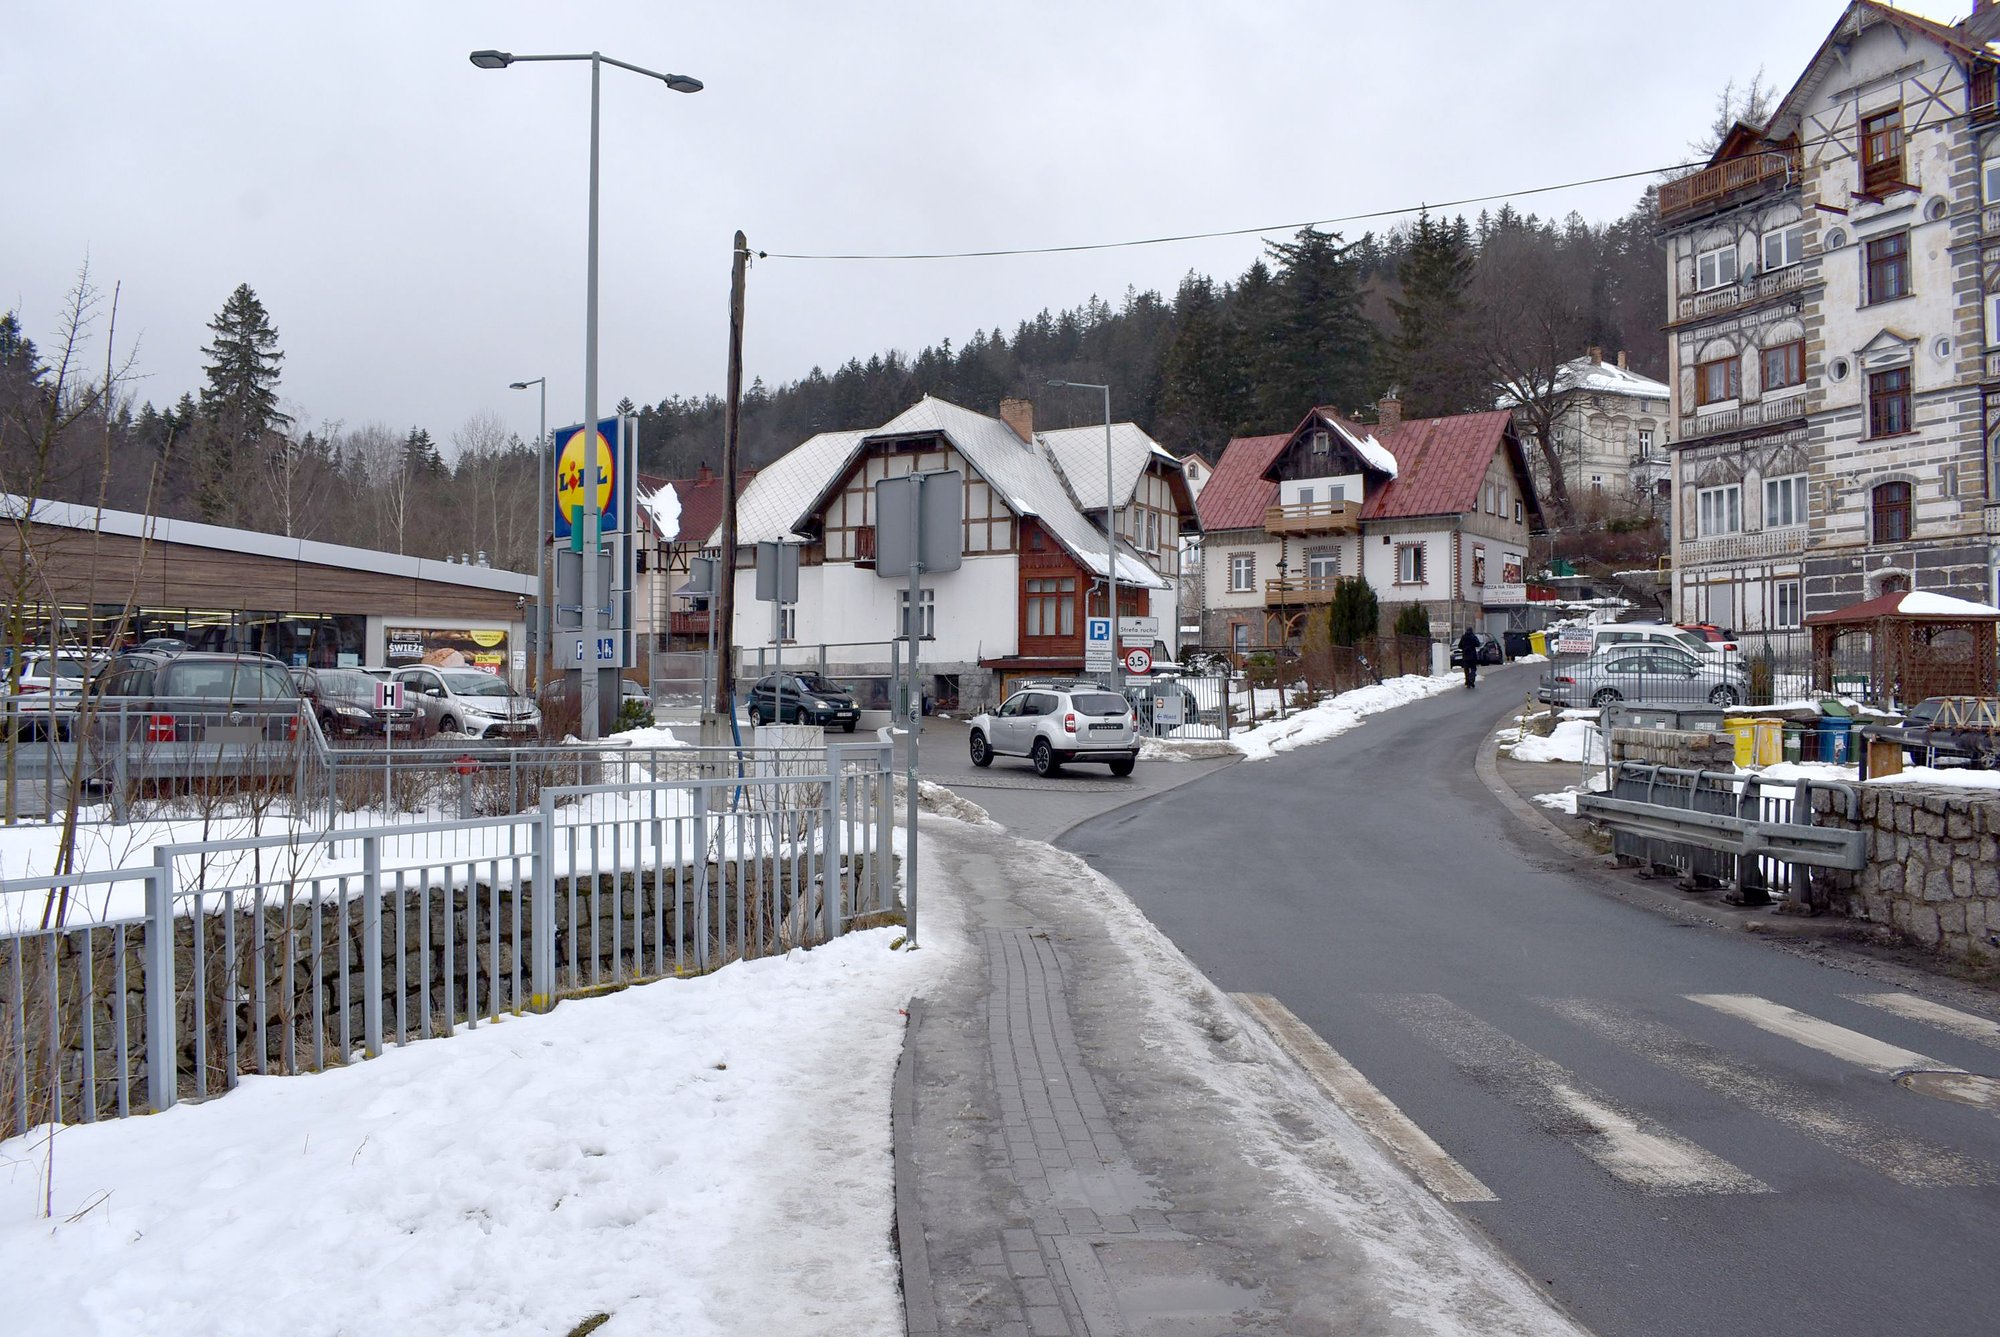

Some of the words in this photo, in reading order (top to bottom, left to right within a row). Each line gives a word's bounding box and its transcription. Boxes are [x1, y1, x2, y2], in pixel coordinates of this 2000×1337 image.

[1094, 622, 1106, 638] P
[389, 643, 424, 653] ŚWIEŻE
[383, 685, 395, 706] H
